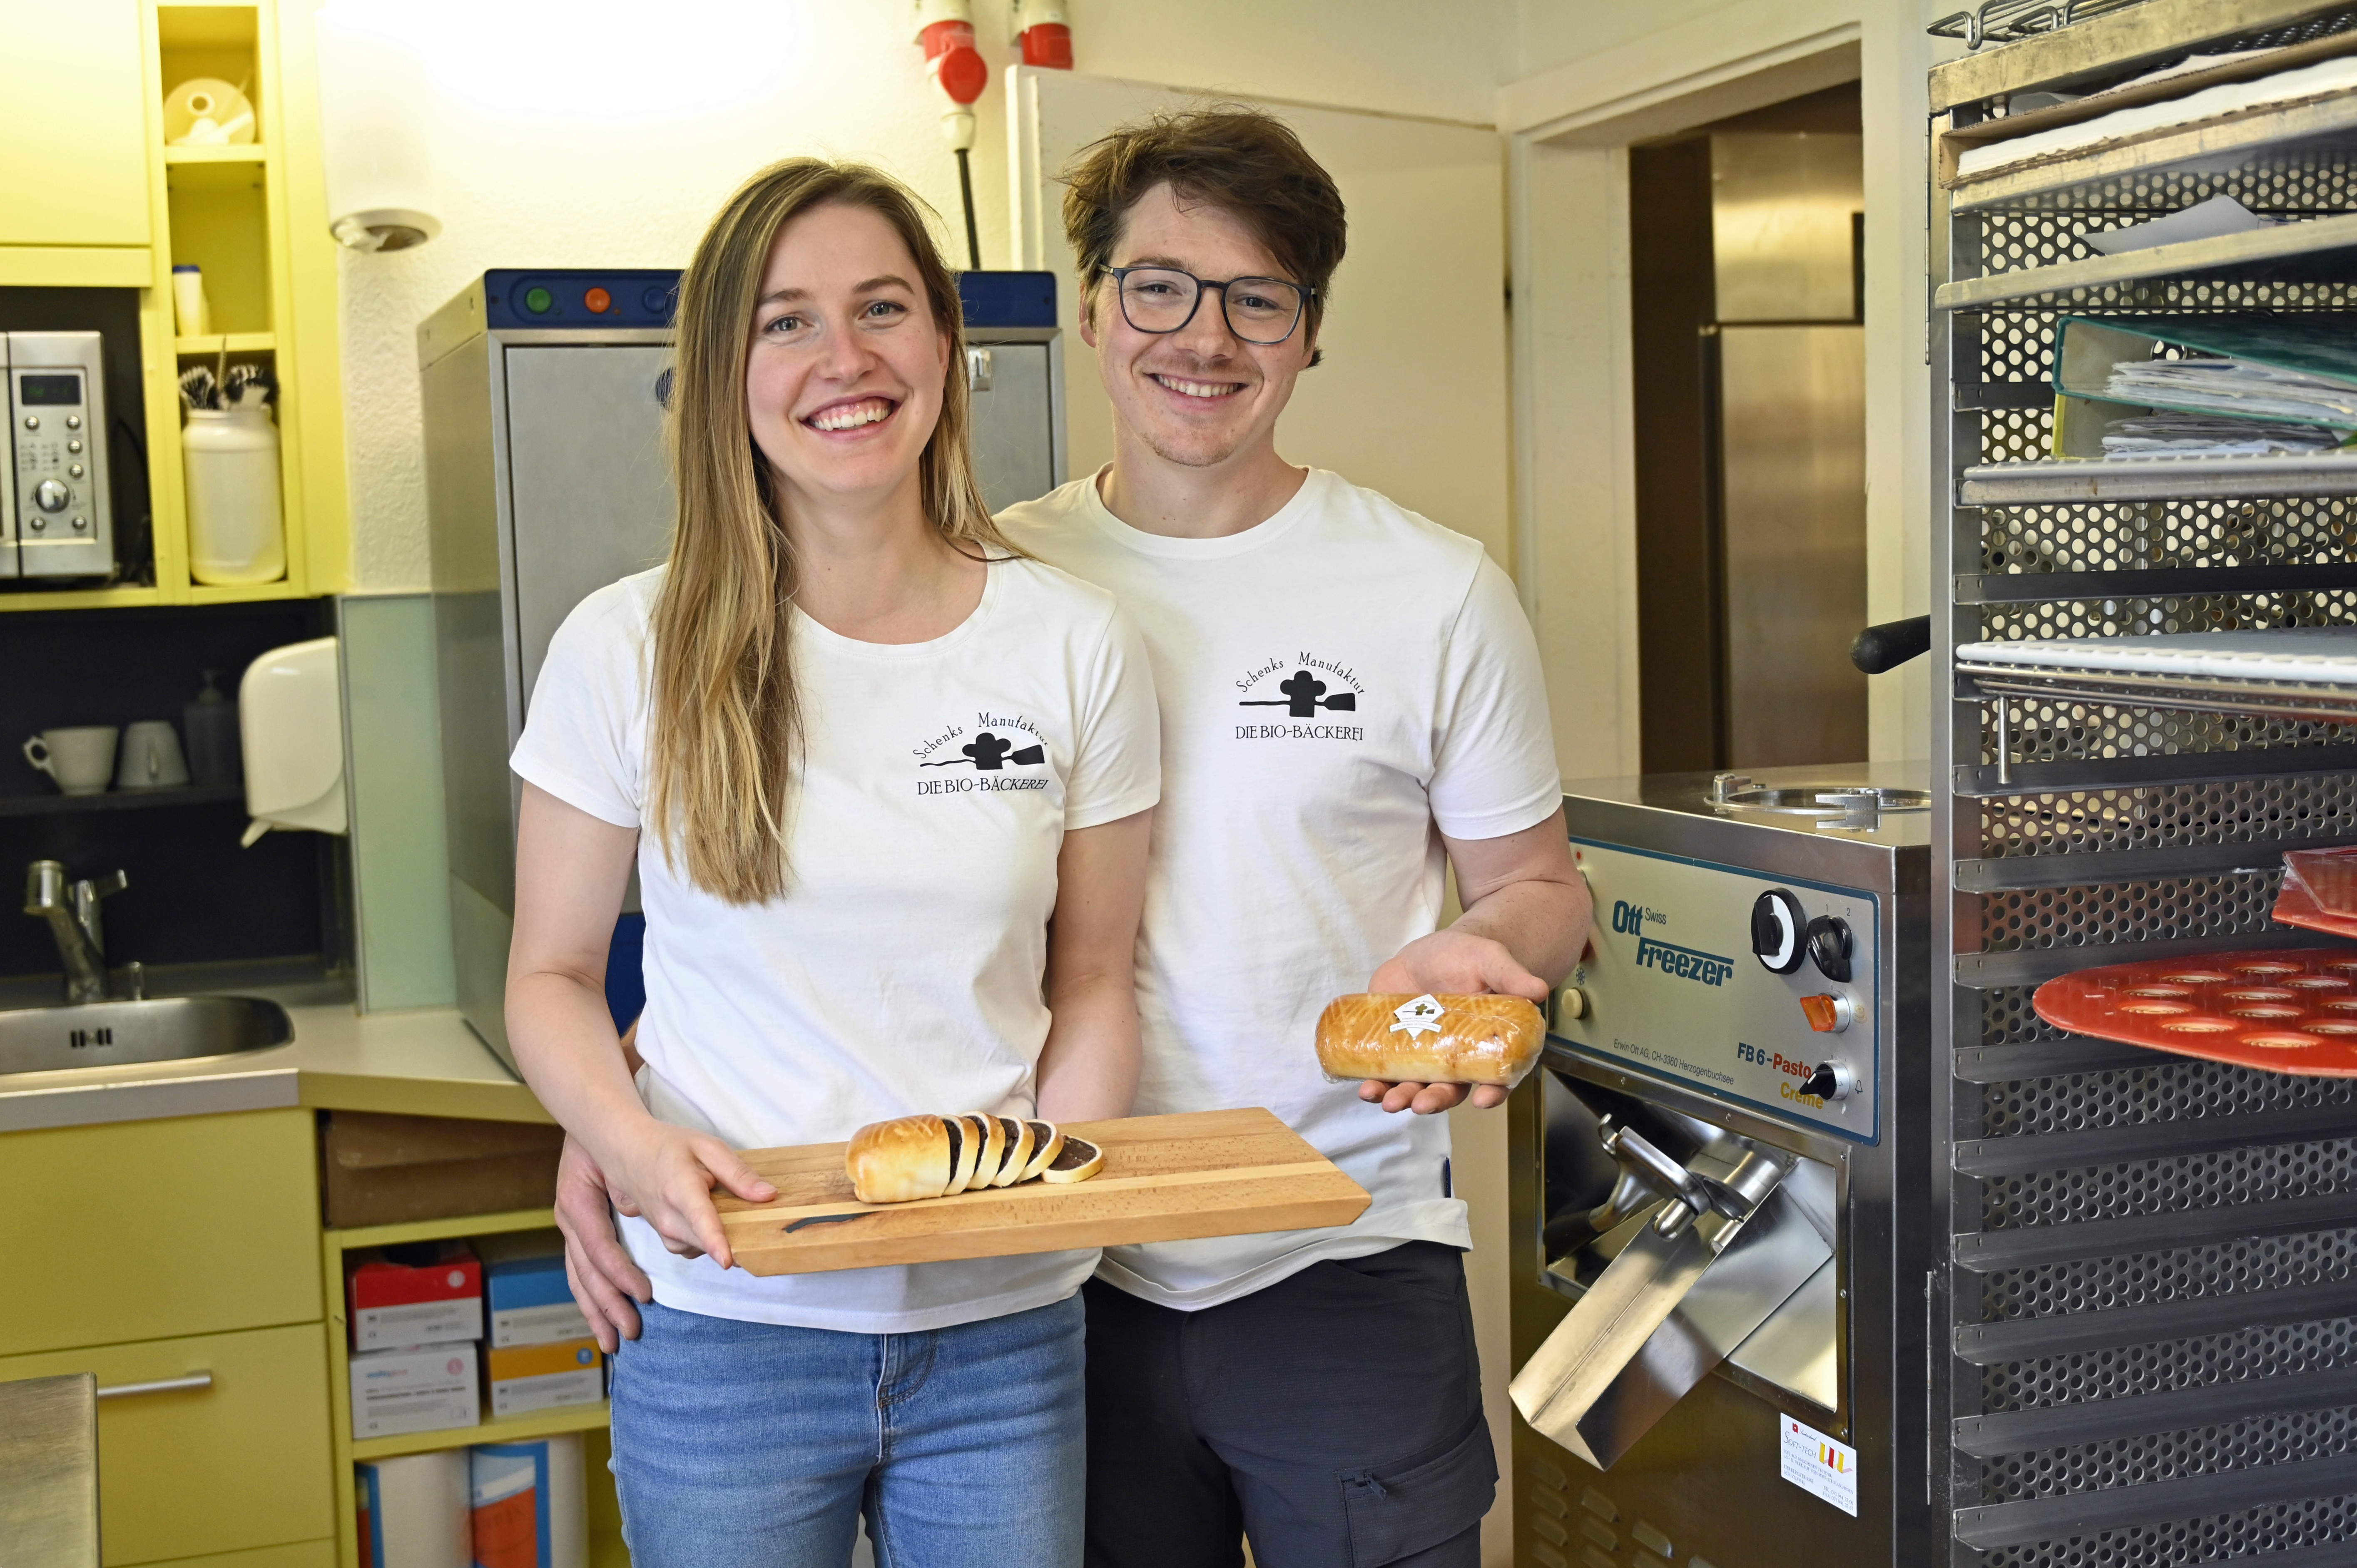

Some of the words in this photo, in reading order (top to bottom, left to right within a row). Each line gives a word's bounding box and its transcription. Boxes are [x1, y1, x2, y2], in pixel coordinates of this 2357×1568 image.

[1236, 658, 1284, 693] Schenks
[1298, 651, 1365, 695] Manufaktur
[913, 725, 963, 759] Schenks
[978, 712, 1048, 746] Manufaktur
[1235, 726, 1257, 739] DIE
[1260, 723, 1363, 741] BIO-BÄCKEREI
[917, 781, 943, 795] DIE
[945, 775, 1049, 793] BIO-BÄCKEREI
[1612, 900, 1643, 936] Ott
[1645, 907, 1666, 925] Swiss
[1826, 904, 1828, 912] 1
[1846, 907, 1850, 917] 2
[1636, 937, 1734, 987] Freezer
[1613, 1039, 1629, 1052] Erwin
[1630, 1044, 1639, 1056] Ott
[1640, 1047, 1650, 1060] AG,
[1651, 1051, 1678, 1067] CH-3360
[1679, 1059, 1734, 1085] Herzogenbuchsee
